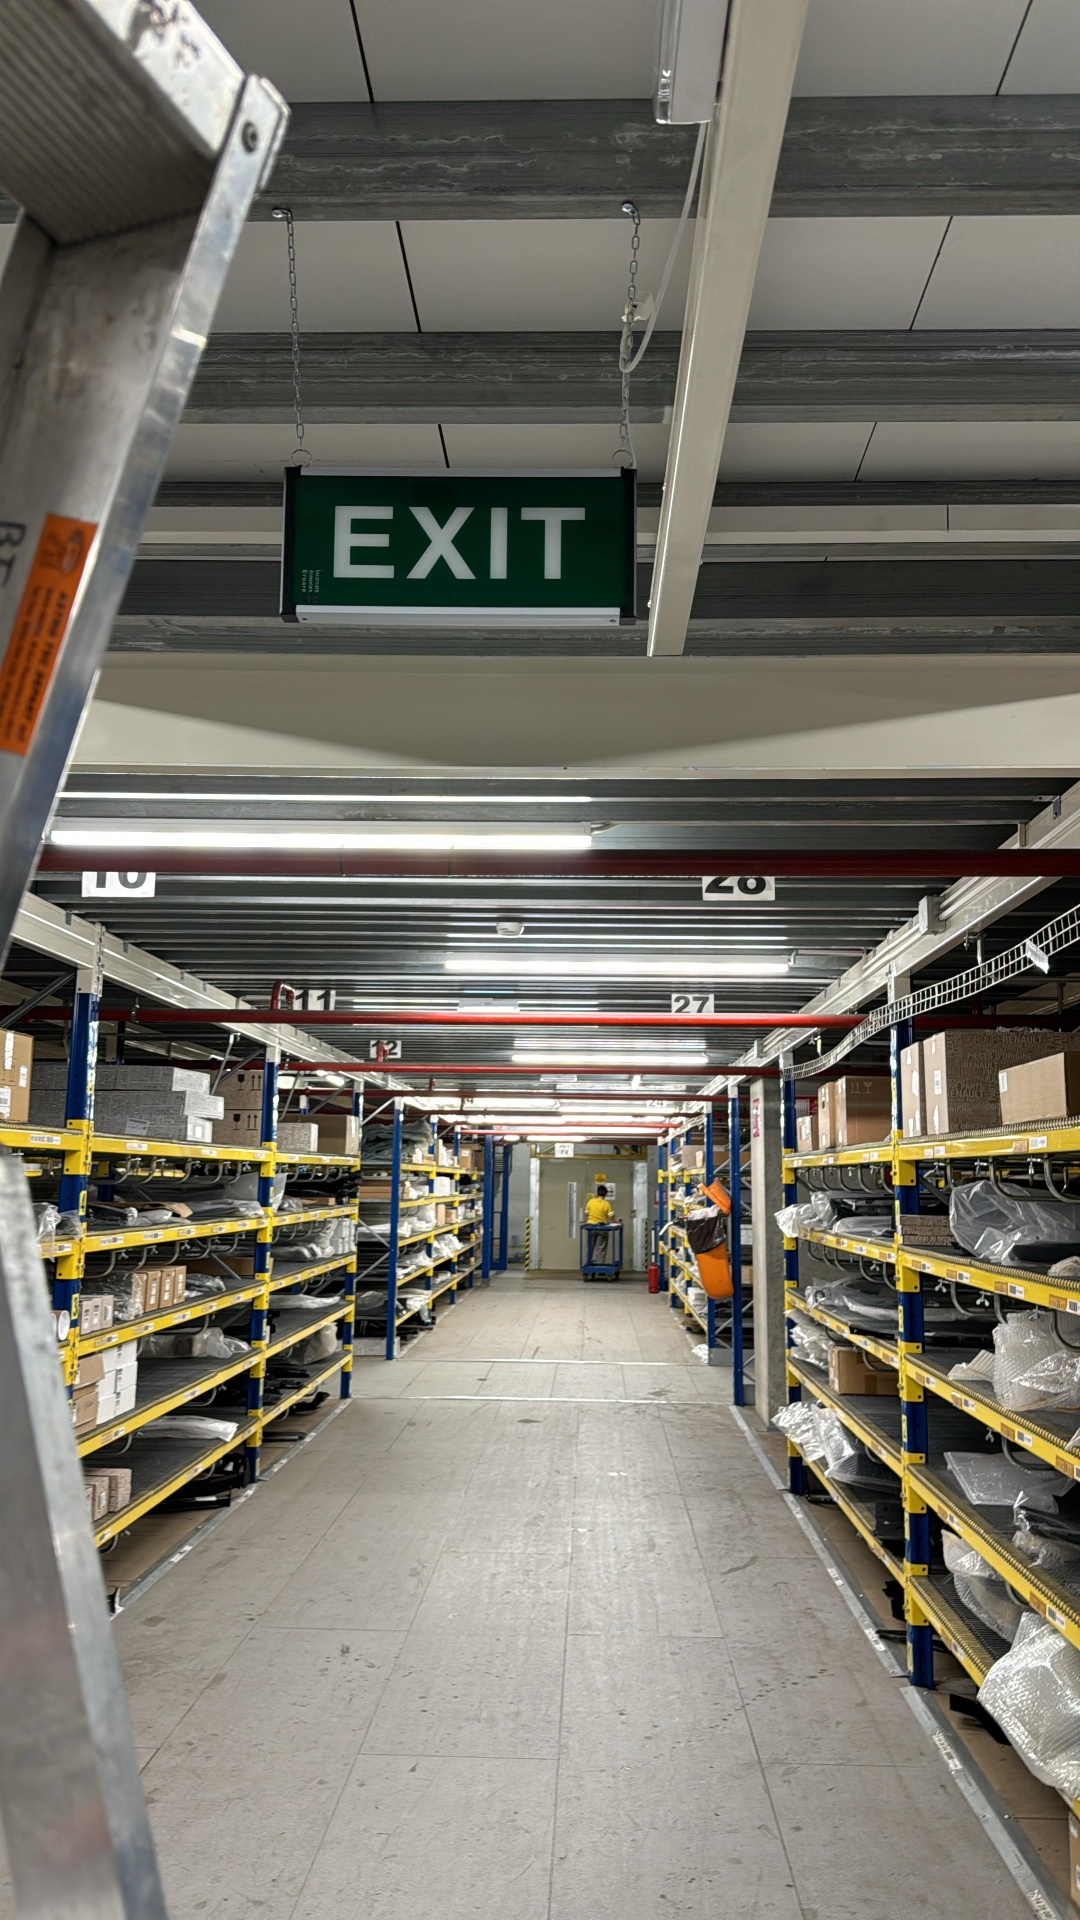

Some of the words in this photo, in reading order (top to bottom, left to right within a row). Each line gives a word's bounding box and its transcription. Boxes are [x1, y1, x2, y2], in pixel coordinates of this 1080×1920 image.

[333, 505, 586, 580] EXIT
[295, 990, 331, 1011] 11
[673, 995, 710, 1013] 27
